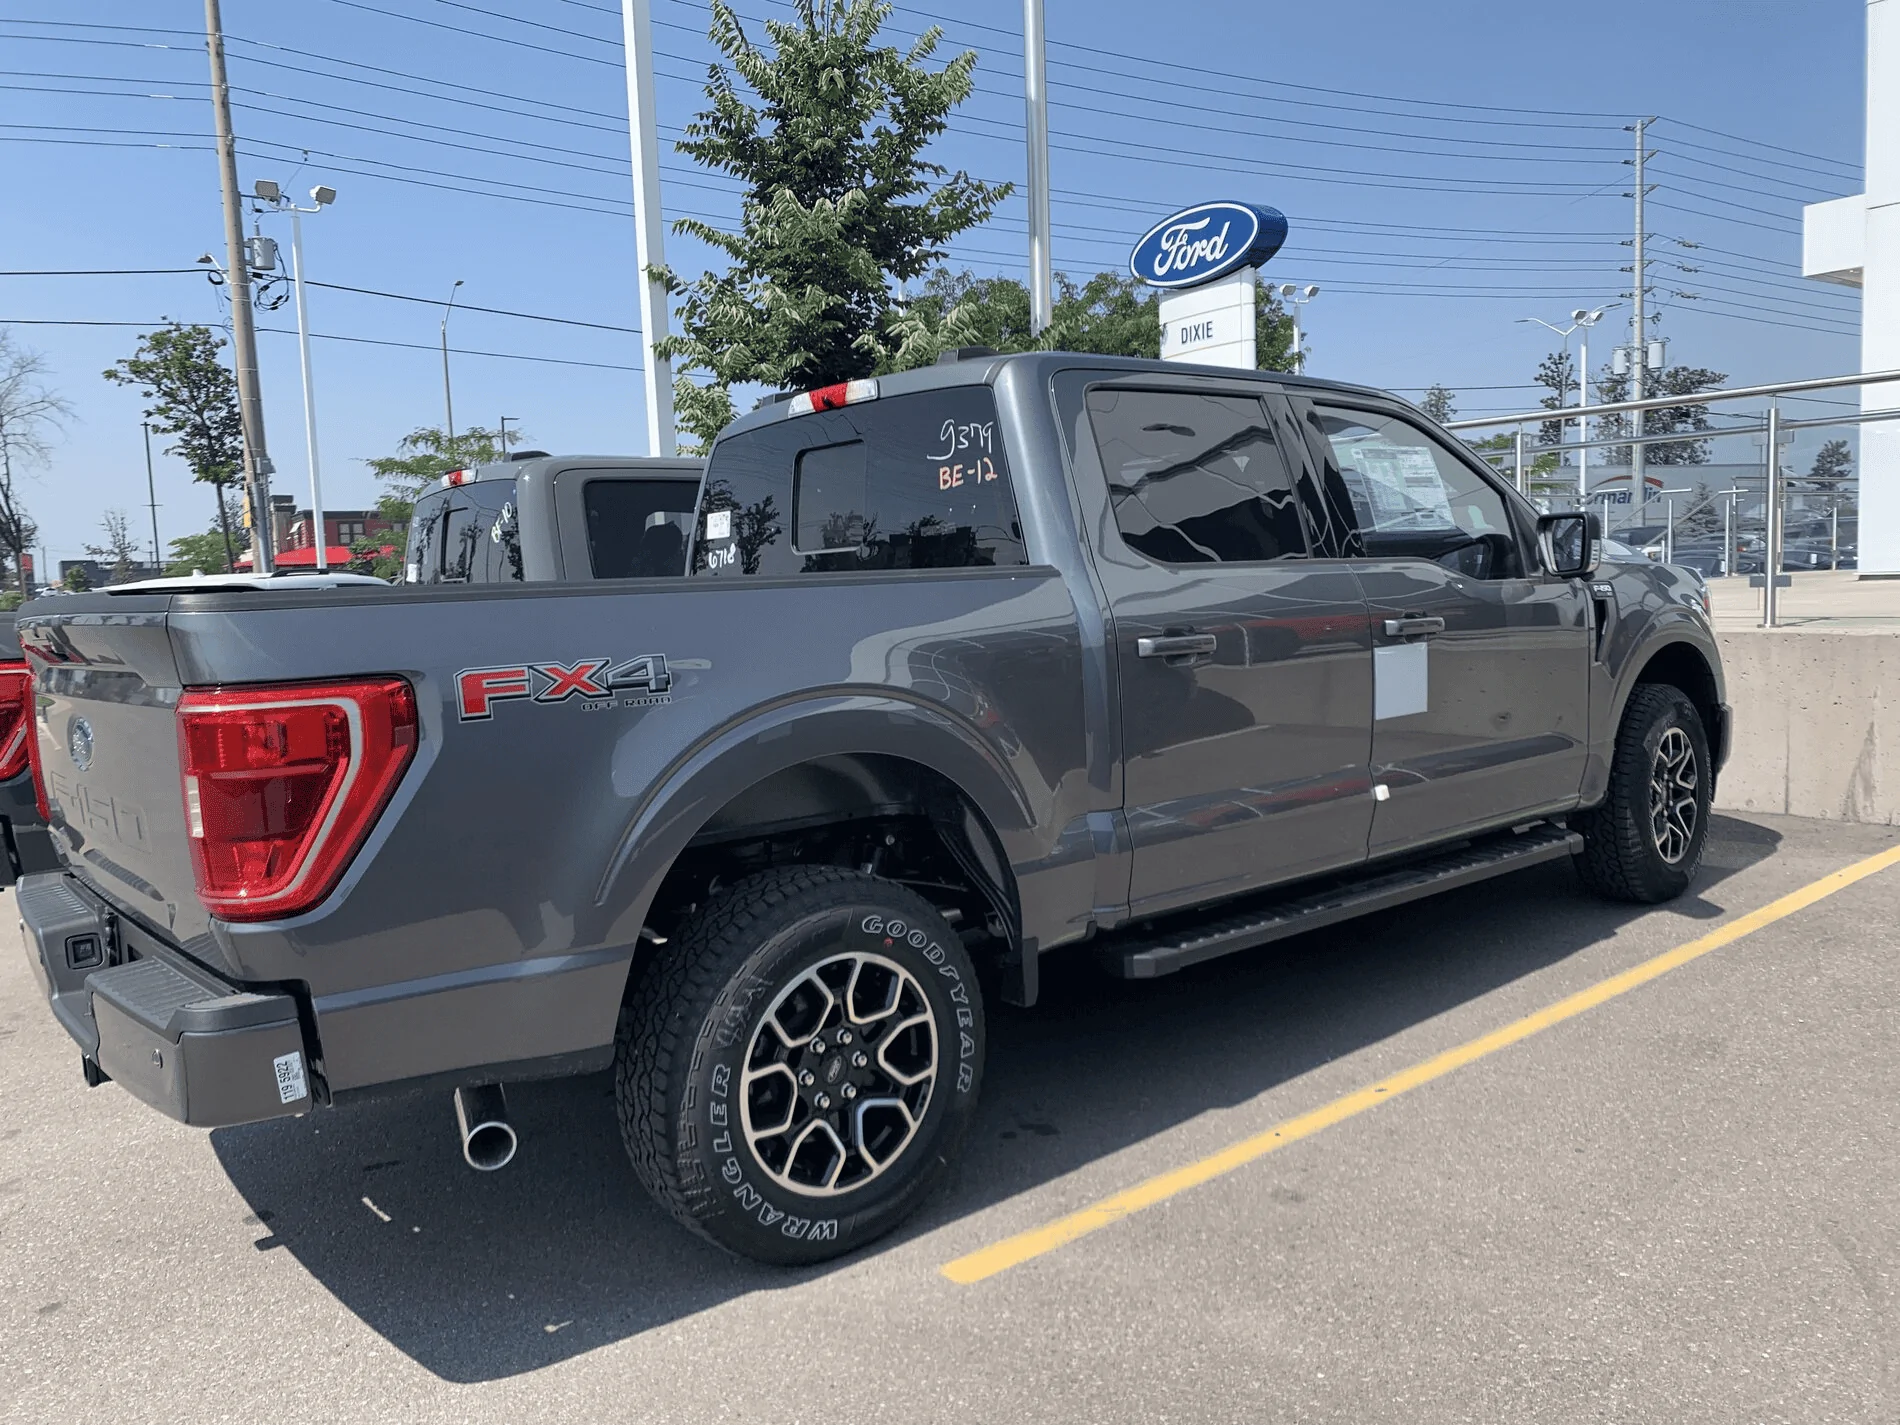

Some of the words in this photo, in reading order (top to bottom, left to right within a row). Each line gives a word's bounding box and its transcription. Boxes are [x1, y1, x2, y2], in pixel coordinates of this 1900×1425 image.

[1153, 216, 1231, 277] Ford
[1181, 321, 1213, 345] DIXIE
[939, 456, 998, 491] BE-12
[708, 543, 736, 569] 6718
[453, 653, 673, 724] FX4
[581, 700, 619, 712] OFF
[624, 695, 673, 708] ROAD
[861, 914, 975, 1093] GOODYEAR
[276, 1060, 291, 1084] 5922
[281, 1084, 295, 1101] 119
[710, 1063, 838, 1241] WRANGLER
